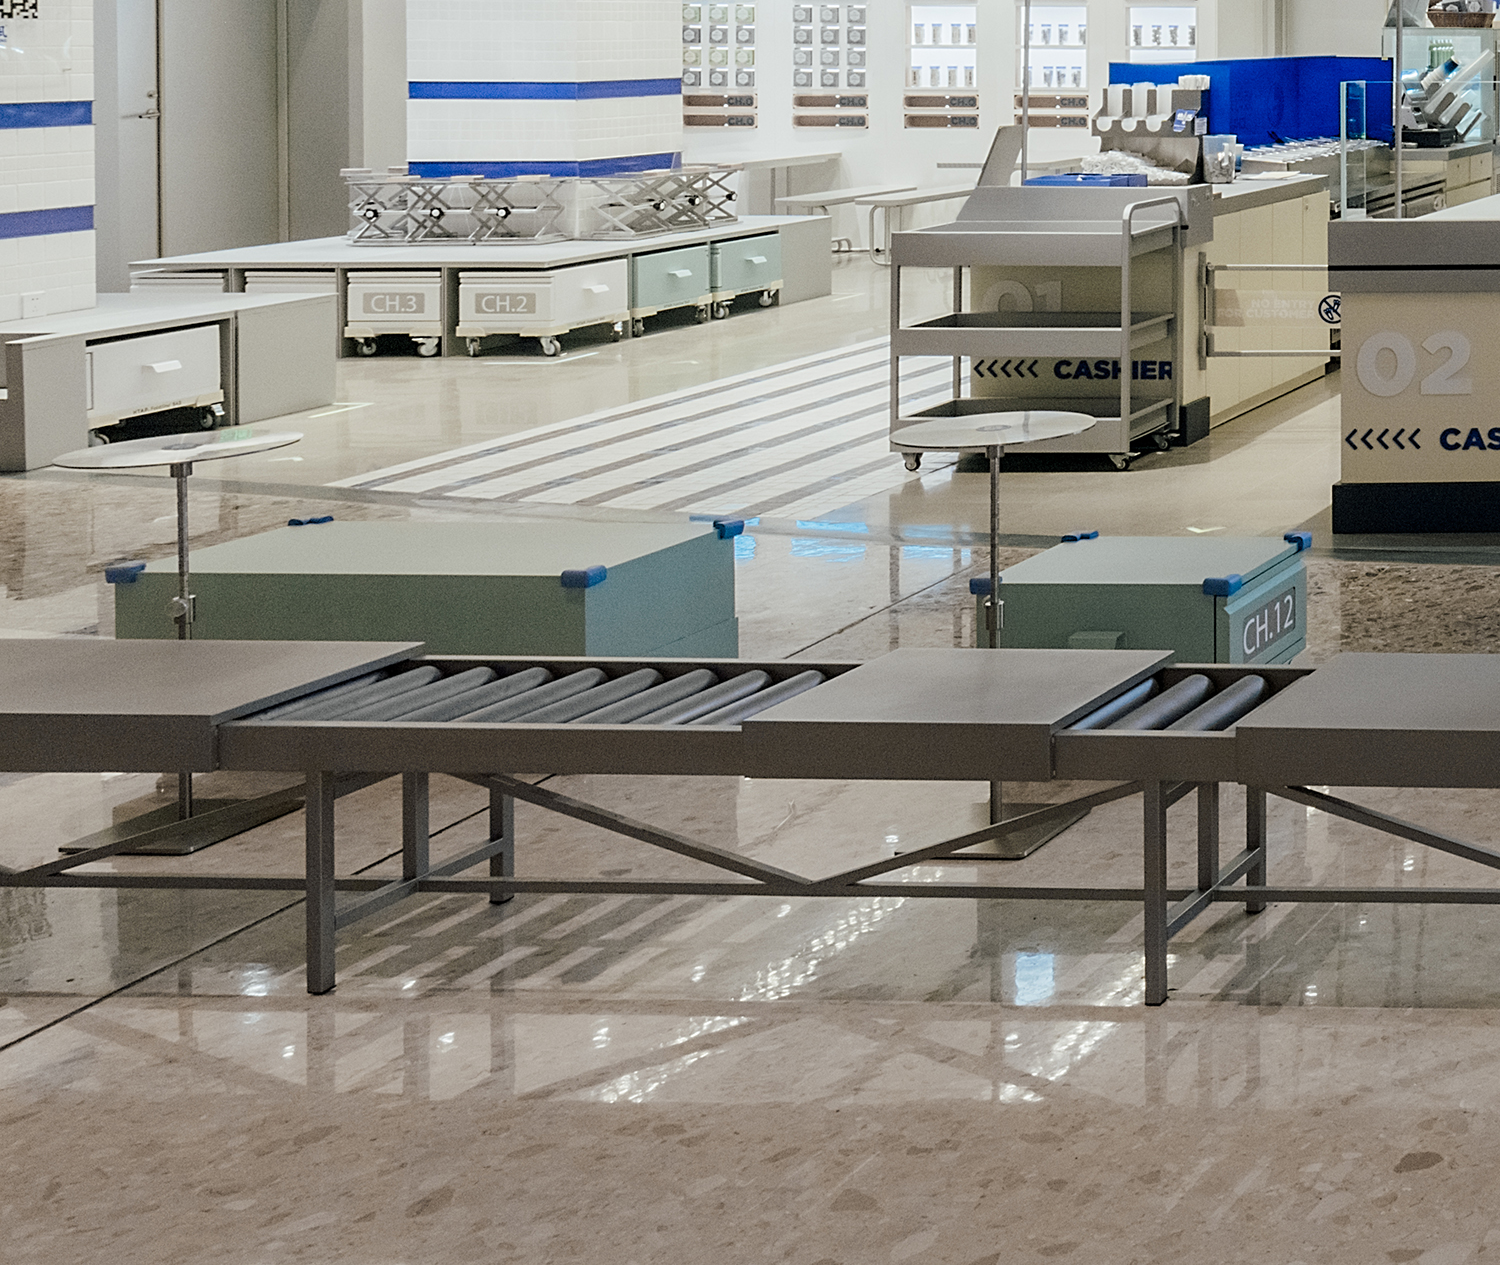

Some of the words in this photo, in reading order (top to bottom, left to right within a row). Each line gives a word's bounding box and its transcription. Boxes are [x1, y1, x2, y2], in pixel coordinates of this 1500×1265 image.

[371, 295, 417, 313] CH.3
[481, 295, 528, 313] CH.2
[1252, 299, 1270, 309] NO
[1273, 300, 1316, 311] ENTRY
[1217, 308, 1243, 319] FOR
[1246, 309, 1316, 320] CUSTOMER
[1053, 359, 1172, 380] CASHIER
[1357, 333, 1472, 396] 02
[1243, 594, 1294, 655] CH.12
